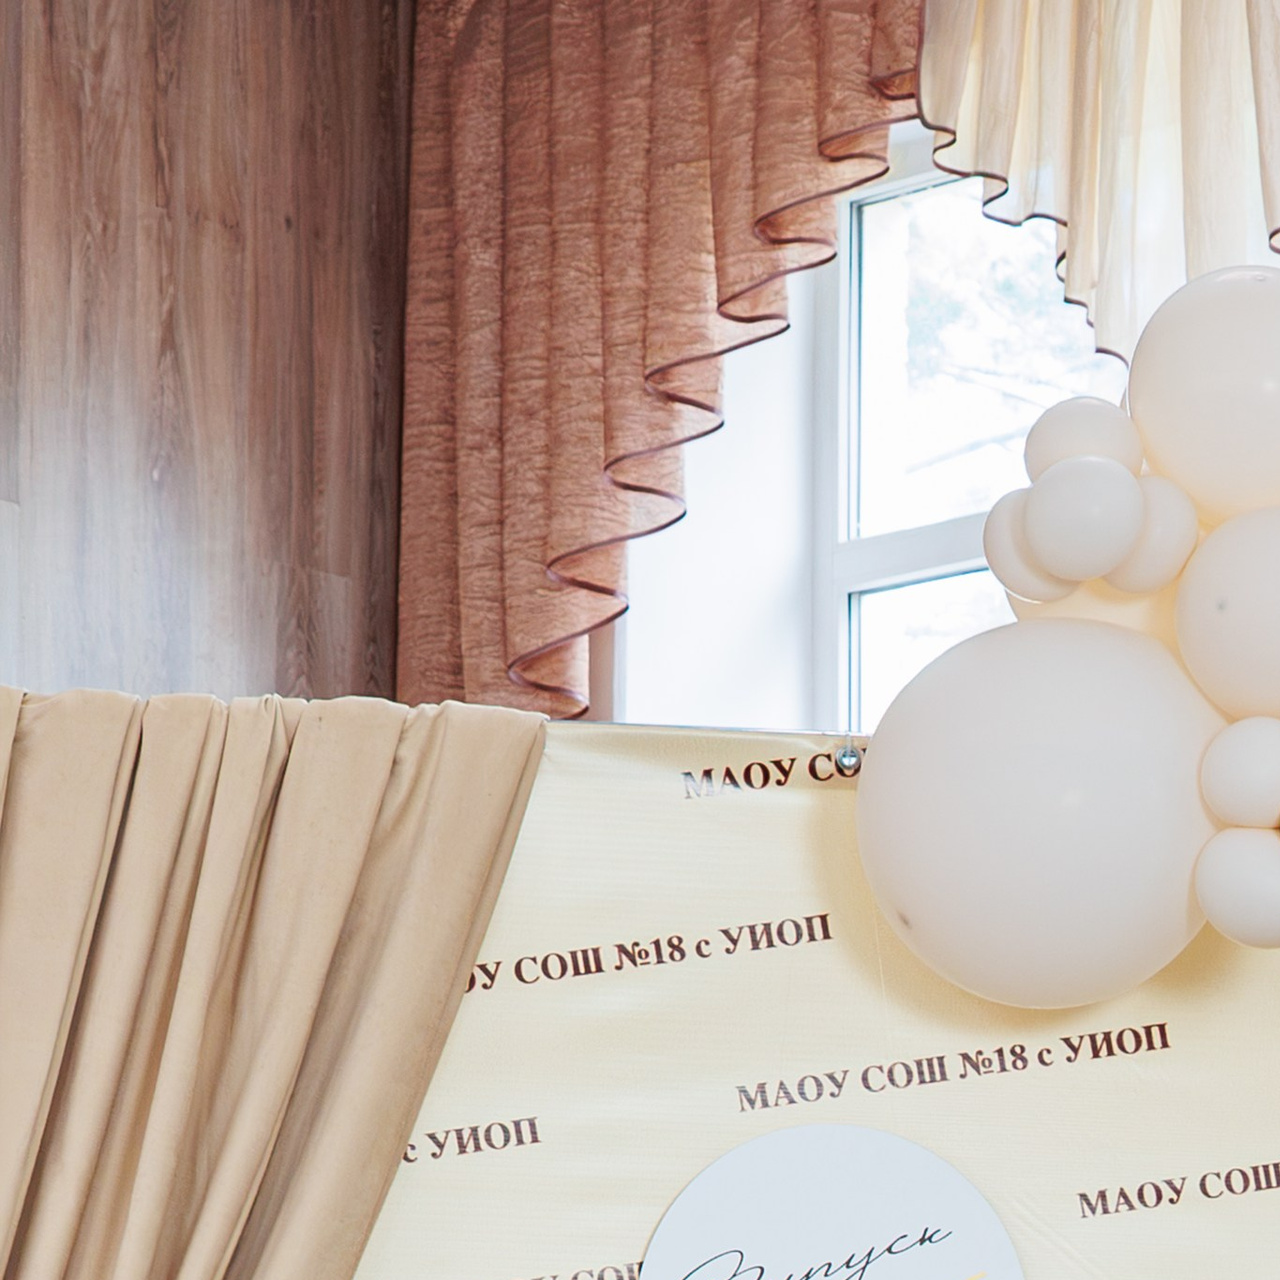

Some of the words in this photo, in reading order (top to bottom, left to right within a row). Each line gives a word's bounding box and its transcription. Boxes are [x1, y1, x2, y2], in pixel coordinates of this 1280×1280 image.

[682, 757, 797, 799] МАОУ
[514, 947, 605, 984] СОШ
[614, 935, 686, 971] №18
[695, 939, 711, 959] с
[719, 913, 832, 955] УИОП
[738, 1069, 850, 1112] МАОУ
[861, 1055, 949, 1093] СОШ
[958, 1044, 1029, 1079] №18
[1037, 1048, 1053, 1067] с
[1060, 1022, 1170, 1063] УИОП
[402, 1143, 418, 1163] с
[425, 1117, 541, 1160] УИОП
[1078, 1177, 1187, 1216] МАОУ
